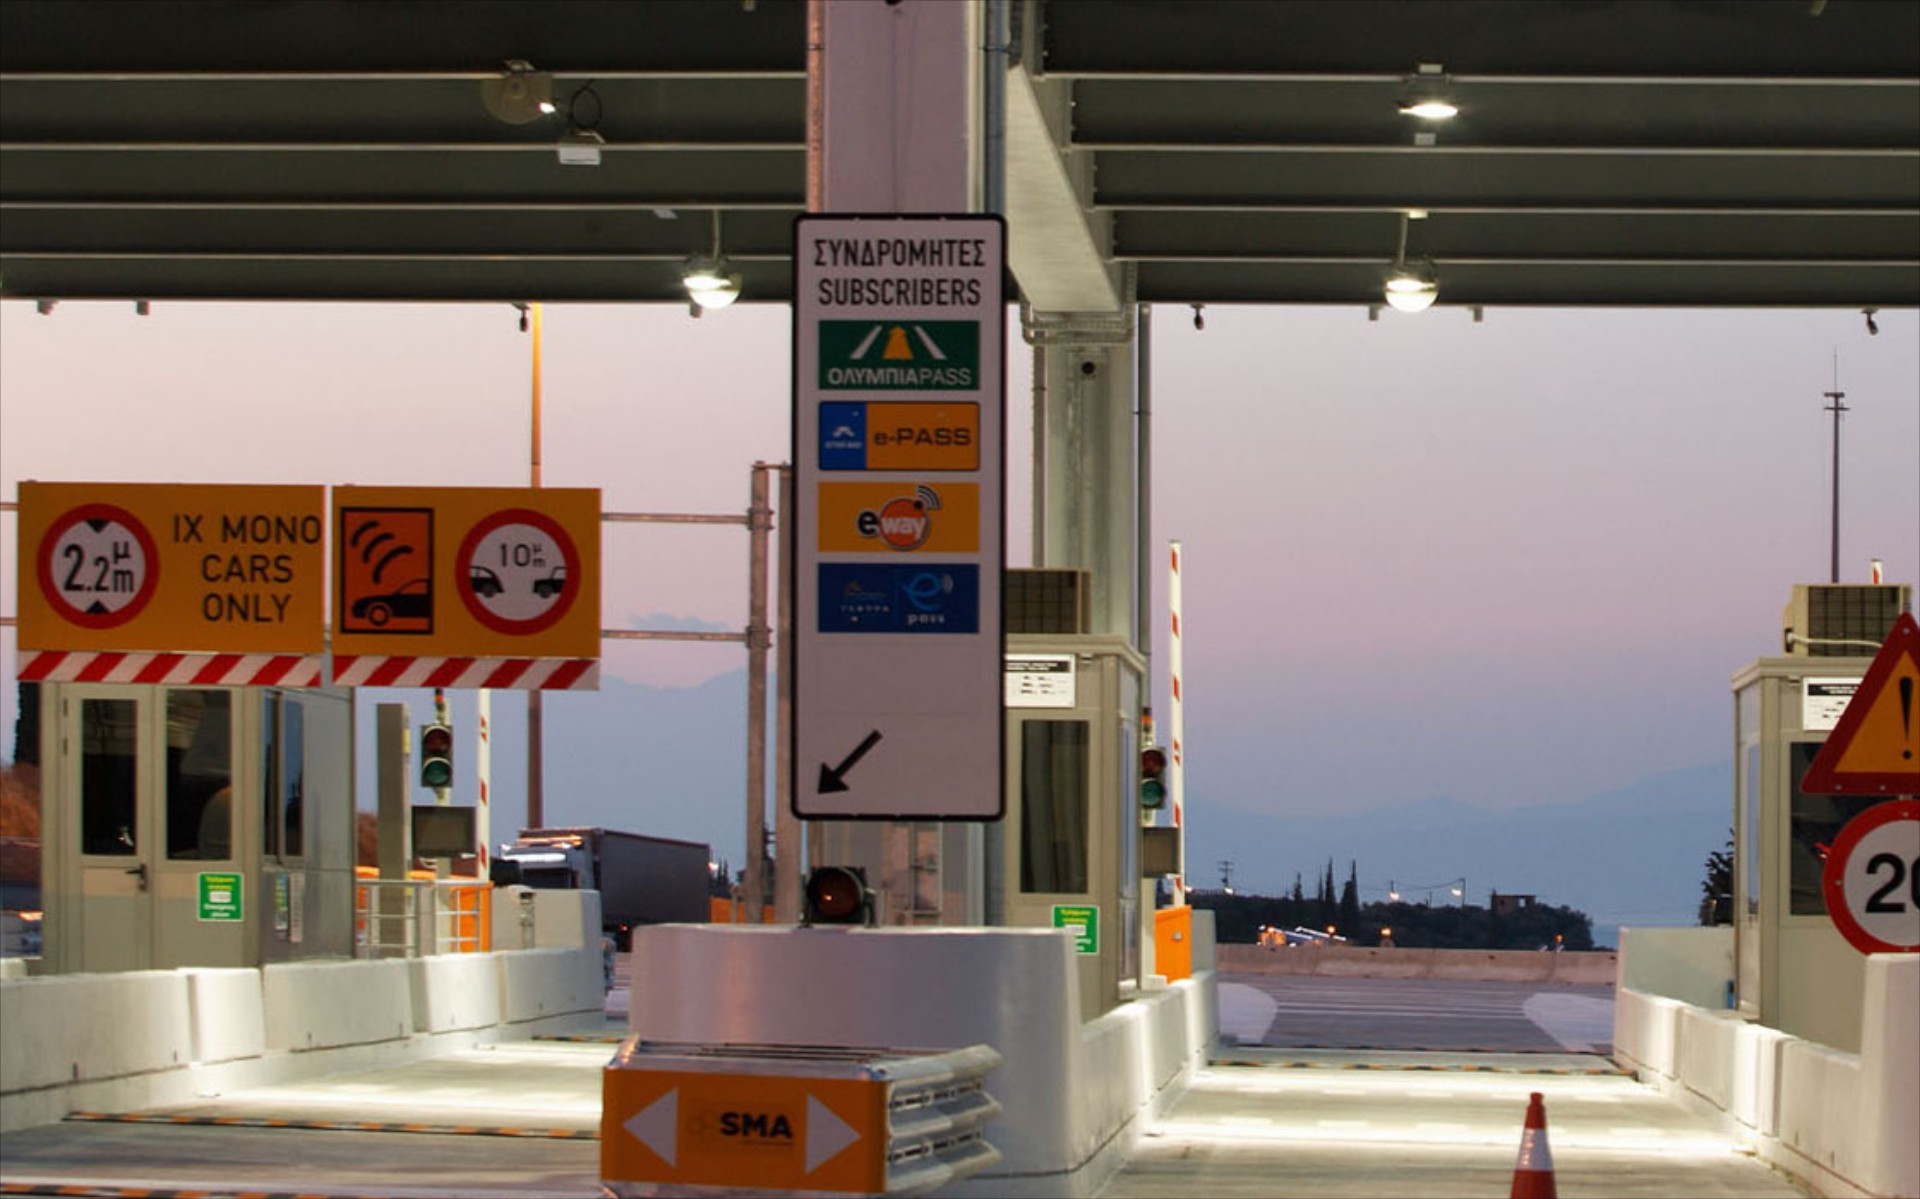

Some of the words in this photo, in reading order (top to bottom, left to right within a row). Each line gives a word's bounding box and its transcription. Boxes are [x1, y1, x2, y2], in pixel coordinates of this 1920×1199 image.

[814, 239, 986, 267] ΣΥΝΔΡΟΜΗΤΕΣ
[818, 277, 982, 306] SUBSCRIBERS
[873, 427, 972, 447] e-PASS
[857, 510, 926, 539] eway
[202, 553, 294, 583] CARS
[500, 542, 531, 568] 10
[202, 594, 292, 623] ONLY
[1865, 852, 1920, 914] 2
[719, 1111, 794, 1140] SMA
